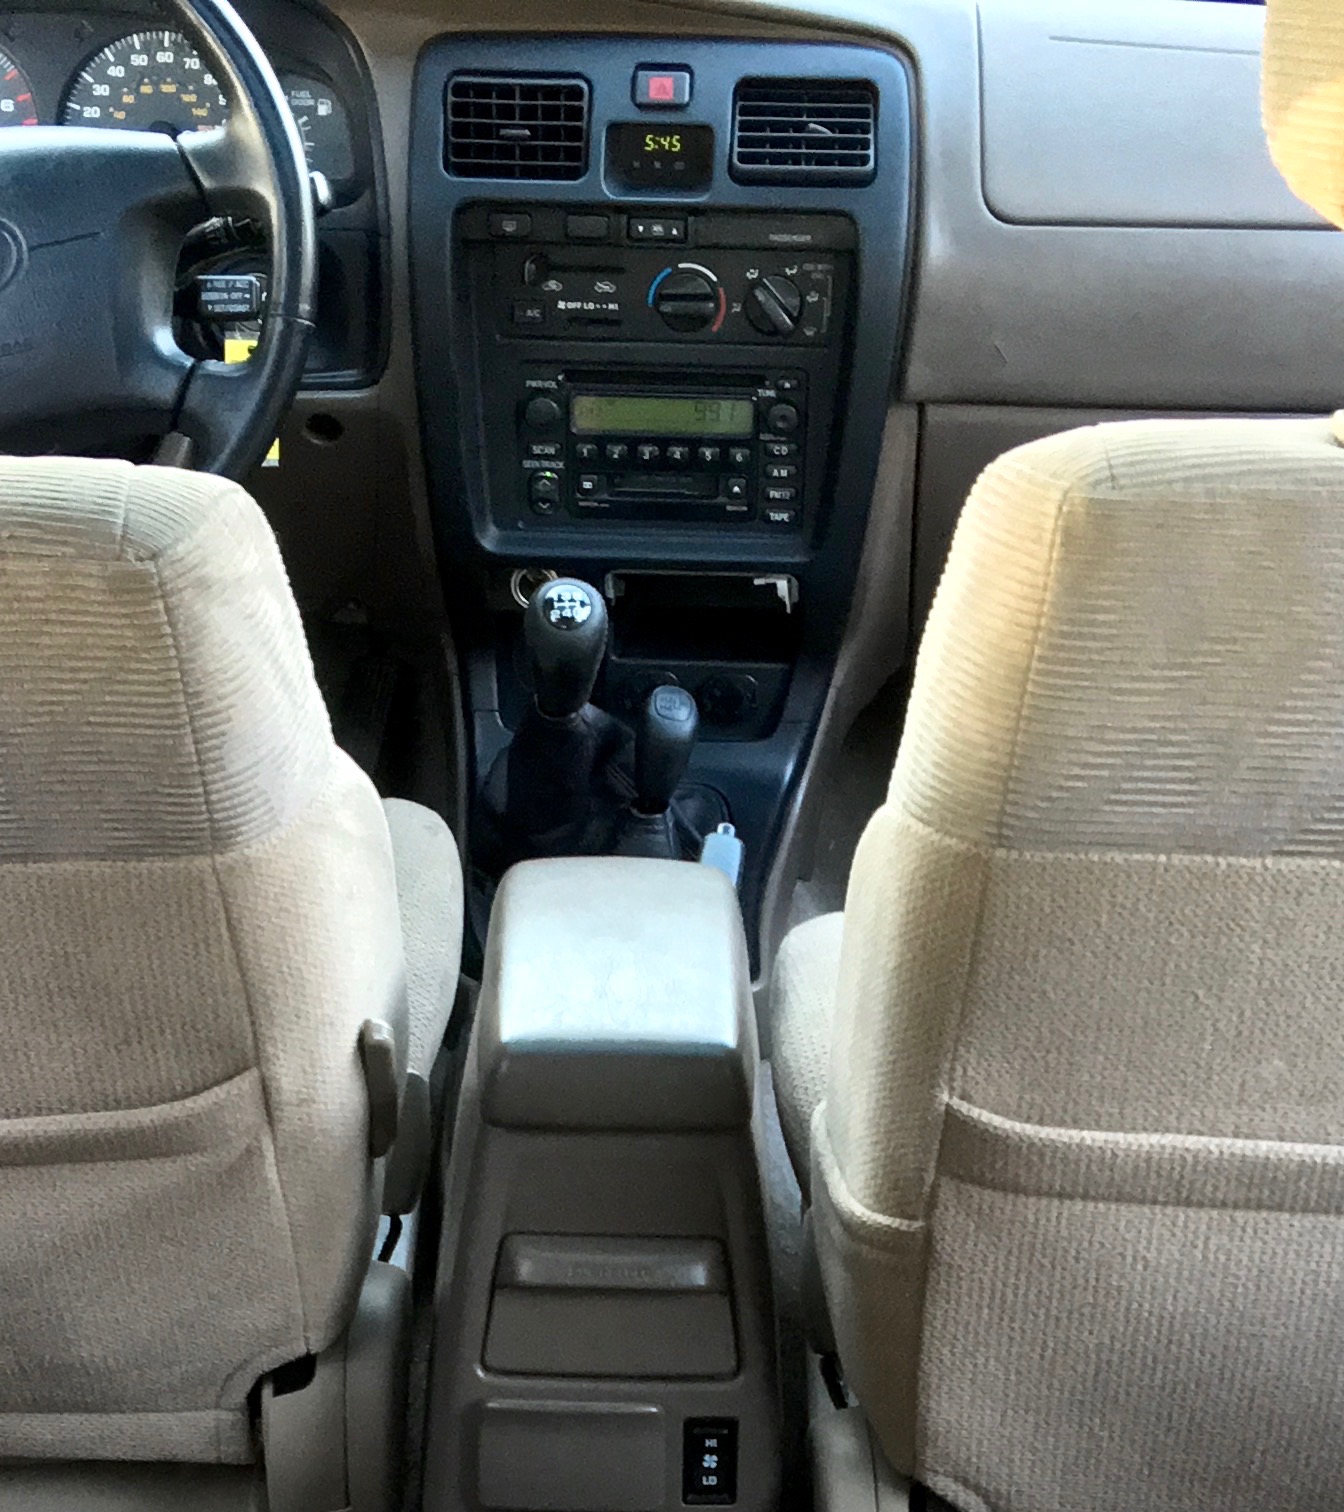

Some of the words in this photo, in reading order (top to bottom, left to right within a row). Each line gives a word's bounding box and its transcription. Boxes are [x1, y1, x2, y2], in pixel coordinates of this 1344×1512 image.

[130, 54, 148, 66] 50
[156, 51, 174, 63] 60
[183, 57, 200, 69] 70
[107, 65, 125, 77] 40
[92, 84, 110, 96] 30
[0, 98, 15, 112] 6
[82, 106, 100, 118] 20
[644, 134, 681, 152] 5:45
[583, 302, 595, 310] LO
[532, 445, 556, 455] SCAN
[735, 452, 743, 462] 6
[769, 512, 790, 522] TAPE
[704, 1438, 718, 1447] HI
[702, 1475, 718, 1486] LO
